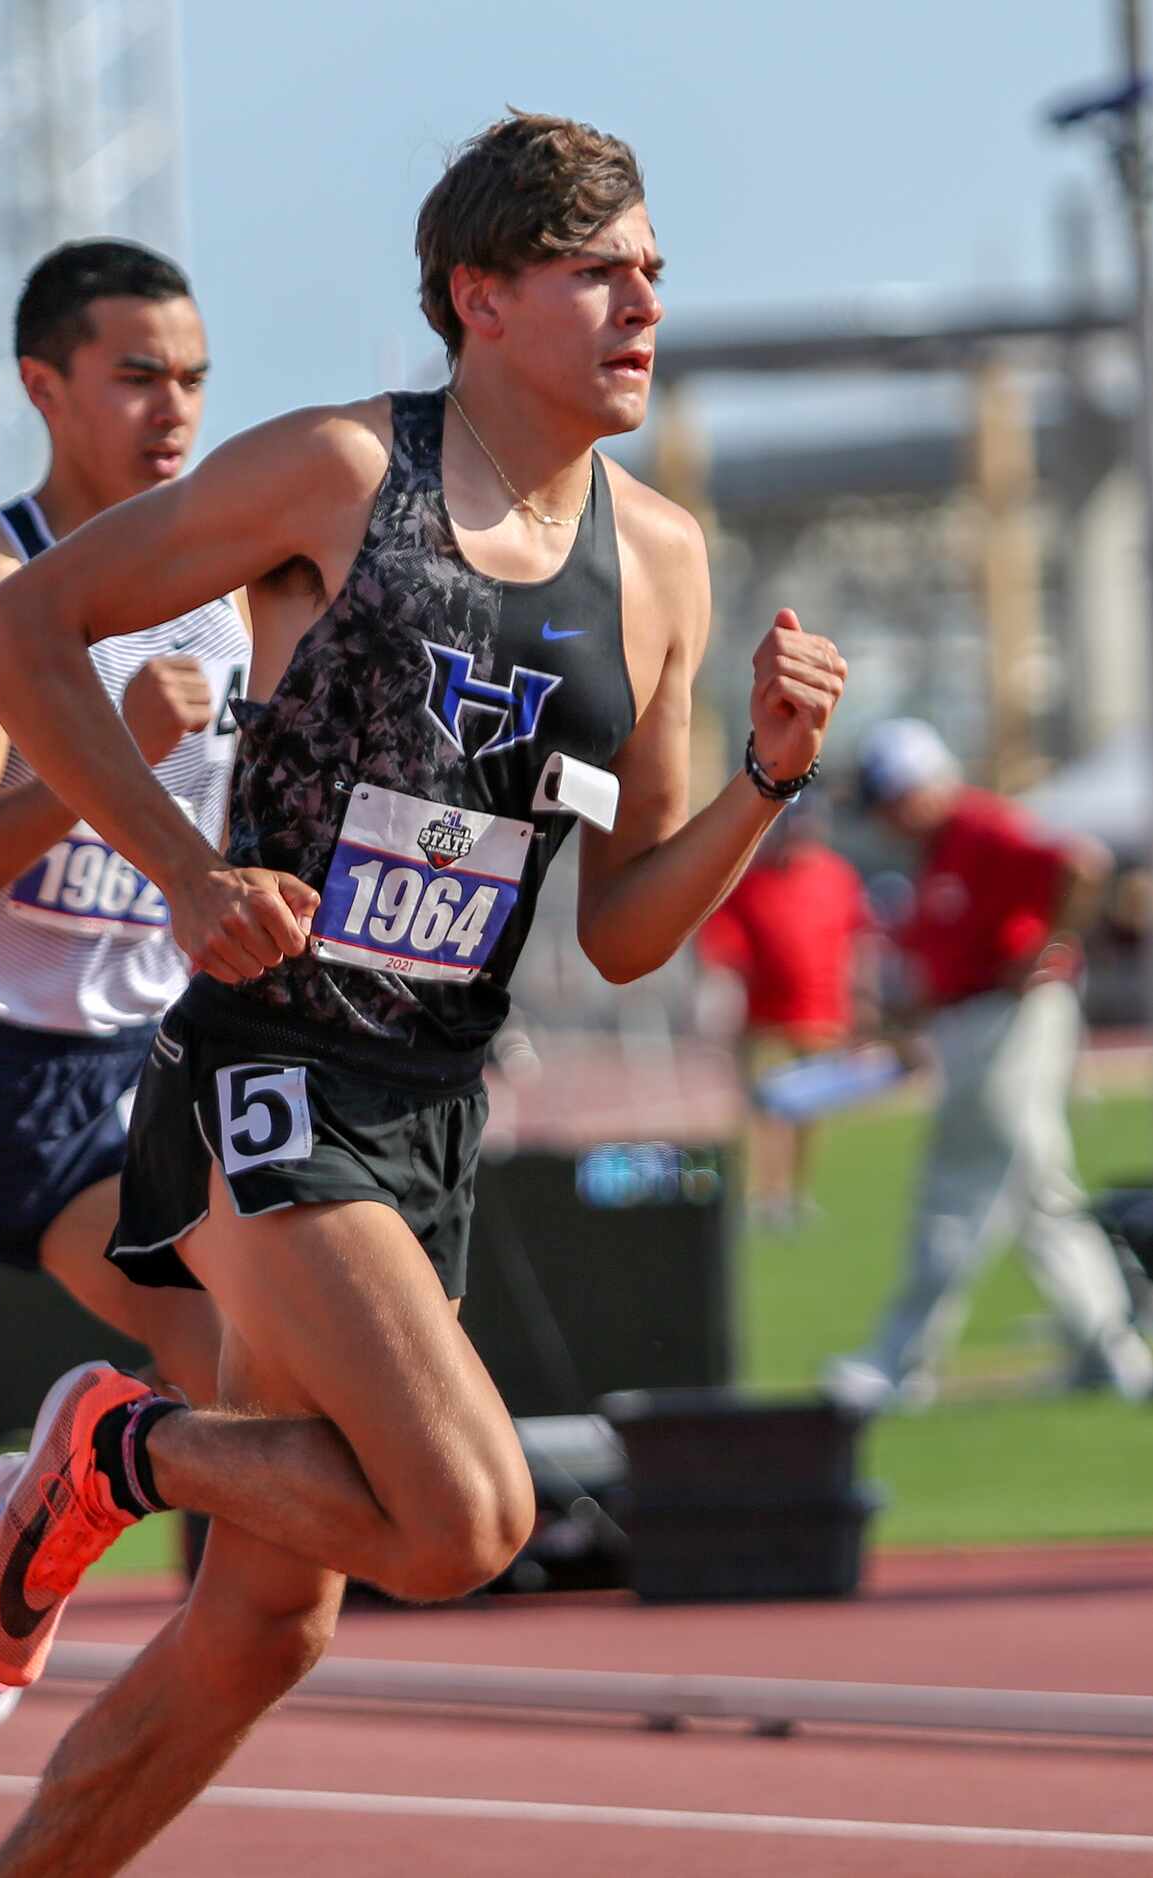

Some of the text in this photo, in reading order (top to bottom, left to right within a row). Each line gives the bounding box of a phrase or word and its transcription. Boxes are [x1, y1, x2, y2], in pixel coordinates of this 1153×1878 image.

[419, 829, 473, 854] STATE
[343, 860, 499, 957] 1964
[385, 957, 415, 973] 2021
[229, 1066, 293, 1156] 5
